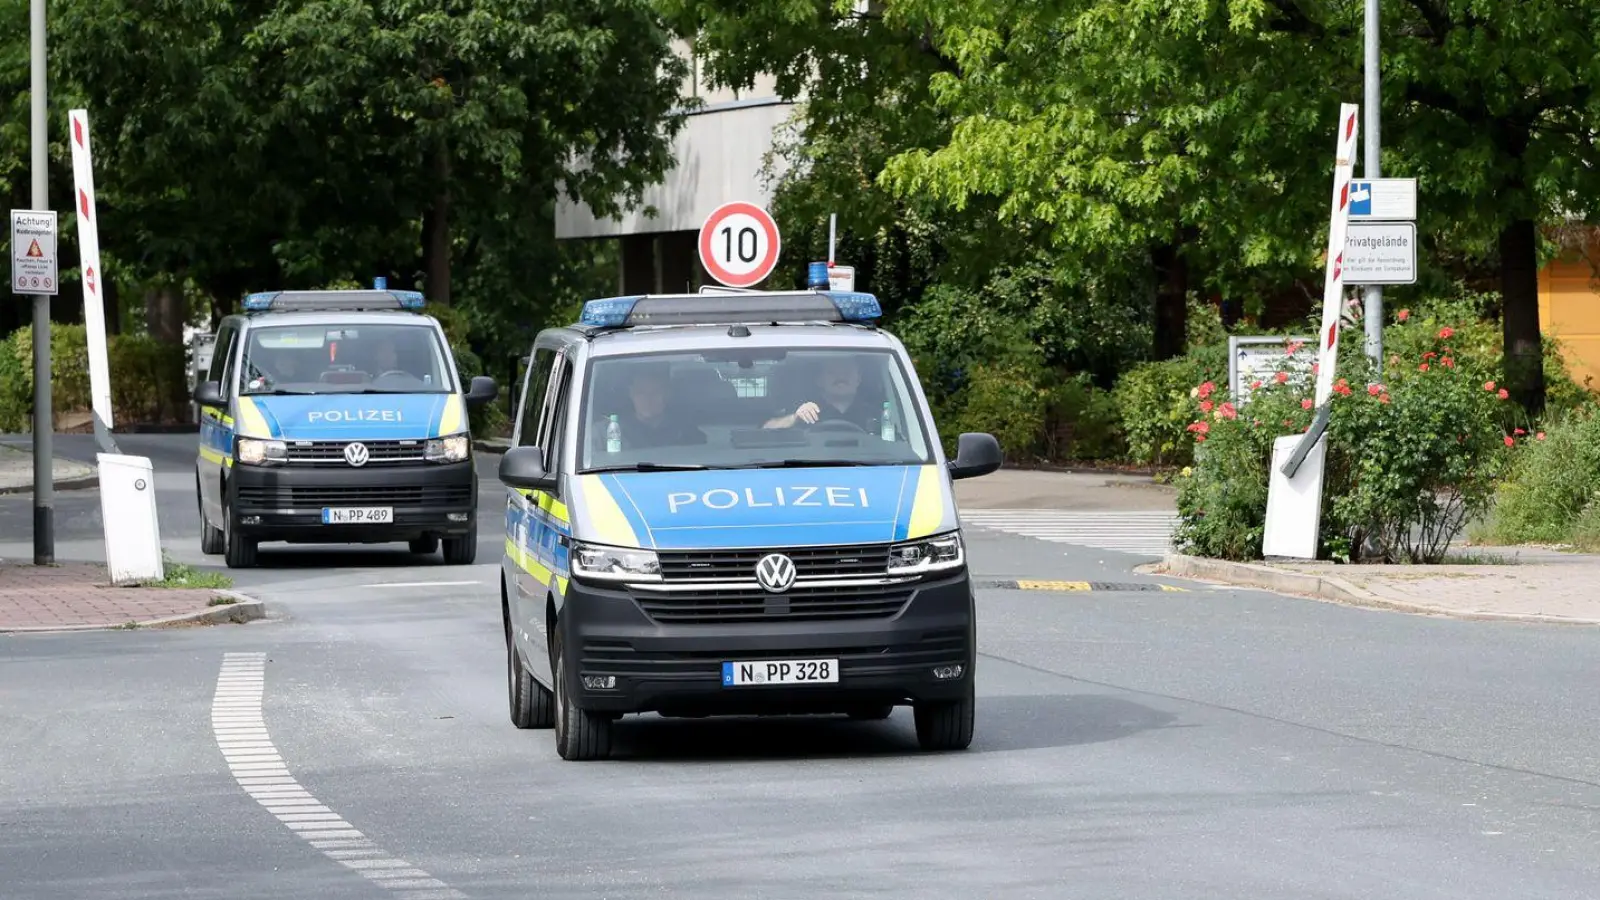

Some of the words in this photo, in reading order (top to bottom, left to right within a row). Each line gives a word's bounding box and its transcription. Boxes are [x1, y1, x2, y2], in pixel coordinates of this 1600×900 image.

[16, 216, 53, 228] Achtung!
[721, 226, 758, 263] 10
[1345, 236, 1408, 249] Privatgelände
[308, 408, 403, 422] POLIZEI
[344, 442, 369, 467] VW
[668, 486, 870, 514] POLIZEI
[333, 510, 342, 520] N
[348, 510, 364, 521] PP
[366, 509, 388, 520] 489
[756, 553, 797, 593] VW
[741, 664, 753, 682] N
[766, 663, 791, 681] PP
[795, 661, 830, 680] 328
